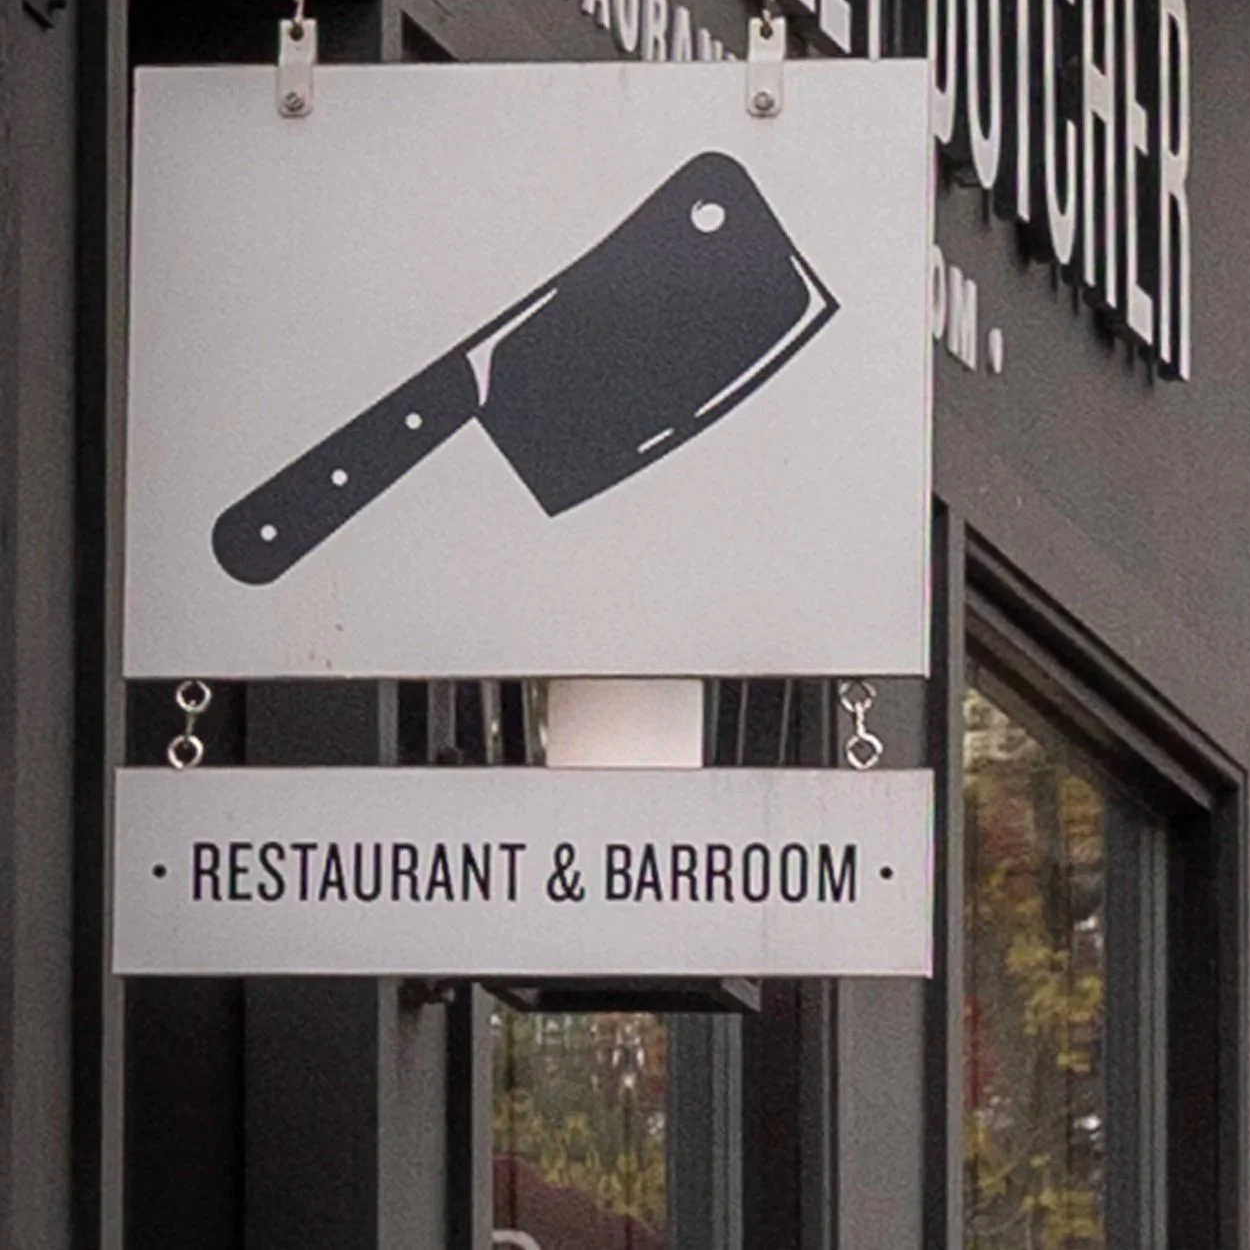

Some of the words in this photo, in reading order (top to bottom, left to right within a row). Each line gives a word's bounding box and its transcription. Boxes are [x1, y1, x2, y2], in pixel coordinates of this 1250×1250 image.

[191, 841, 527, 902] RESTAURANT
[546, 842, 585, 902] &
[604, 842, 857, 903] BARROOM
